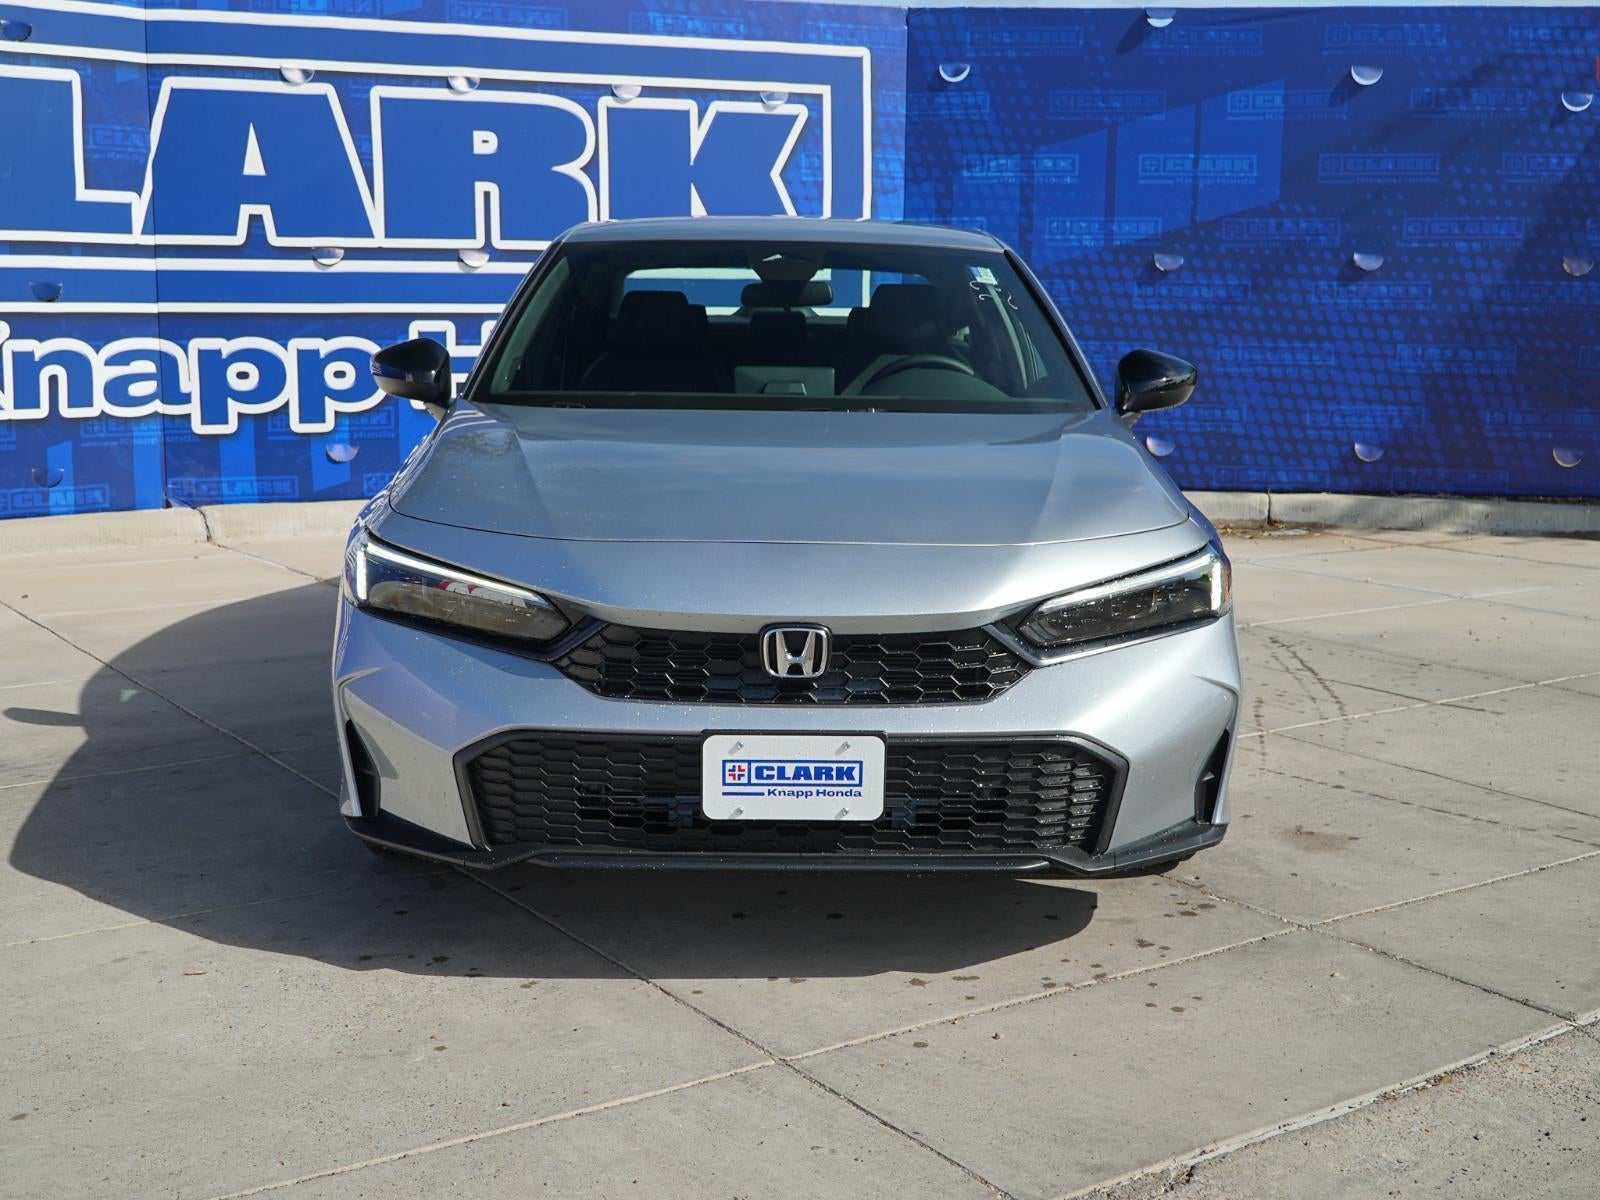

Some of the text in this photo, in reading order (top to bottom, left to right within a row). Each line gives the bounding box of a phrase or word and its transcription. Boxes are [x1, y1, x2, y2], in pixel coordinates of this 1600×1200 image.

[0, 320, 388, 434] napp
[754, 765, 856, 781] CLARK
[767, 788, 862, 799] Knapp Honda
